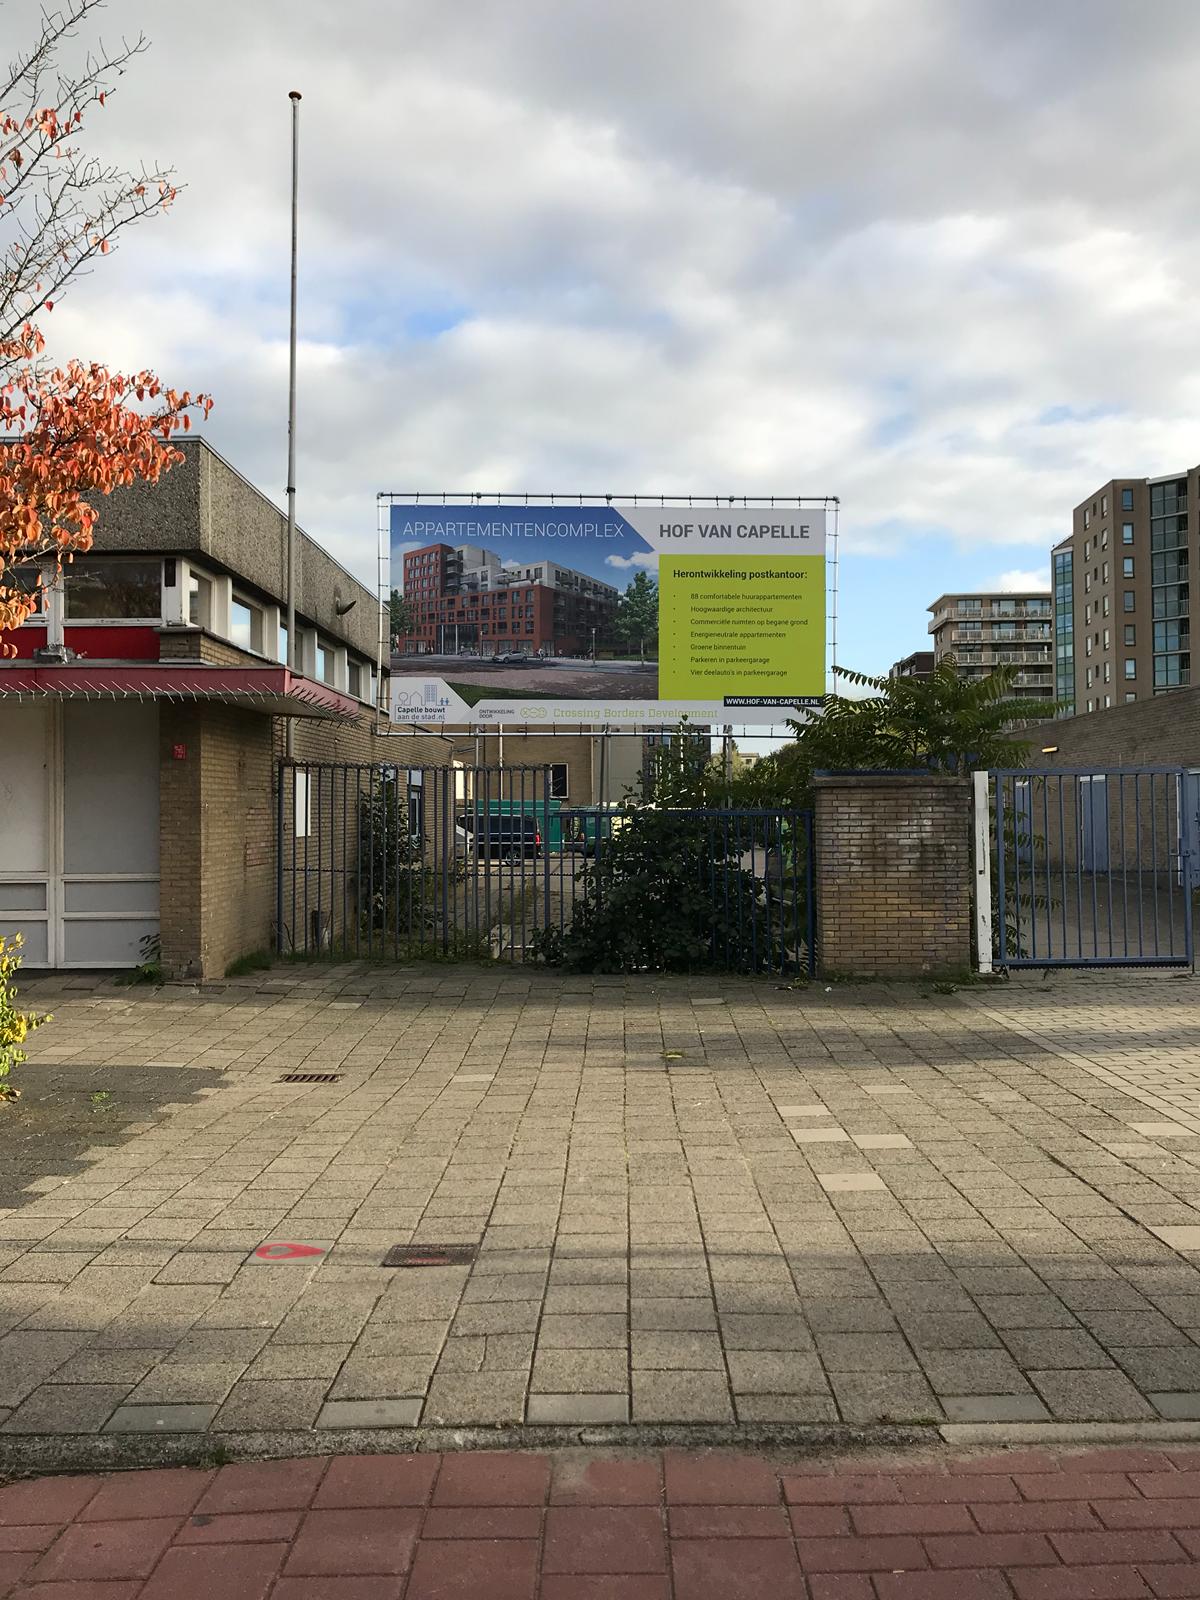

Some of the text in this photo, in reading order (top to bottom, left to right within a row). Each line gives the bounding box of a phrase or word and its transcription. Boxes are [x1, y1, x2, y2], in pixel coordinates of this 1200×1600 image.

[403, 522, 625, 537] APPARTEMENTENCOMPLEX
[659, 524, 810, 539] HOF VAN CAPELLE
[673, 569, 808, 580] Herontwikkeling postkantoor:
[742, 593, 802, 602] huurappartementen
[789, 619, 808, 627] grond
[739, 631, 786, 639] appartementen
[726, 656, 770, 664] parkeergarage
[743, 669, 788, 677] parkeergarage
[553, 708, 600, 719] Crossing
[604, 707, 645, 718] Borders
